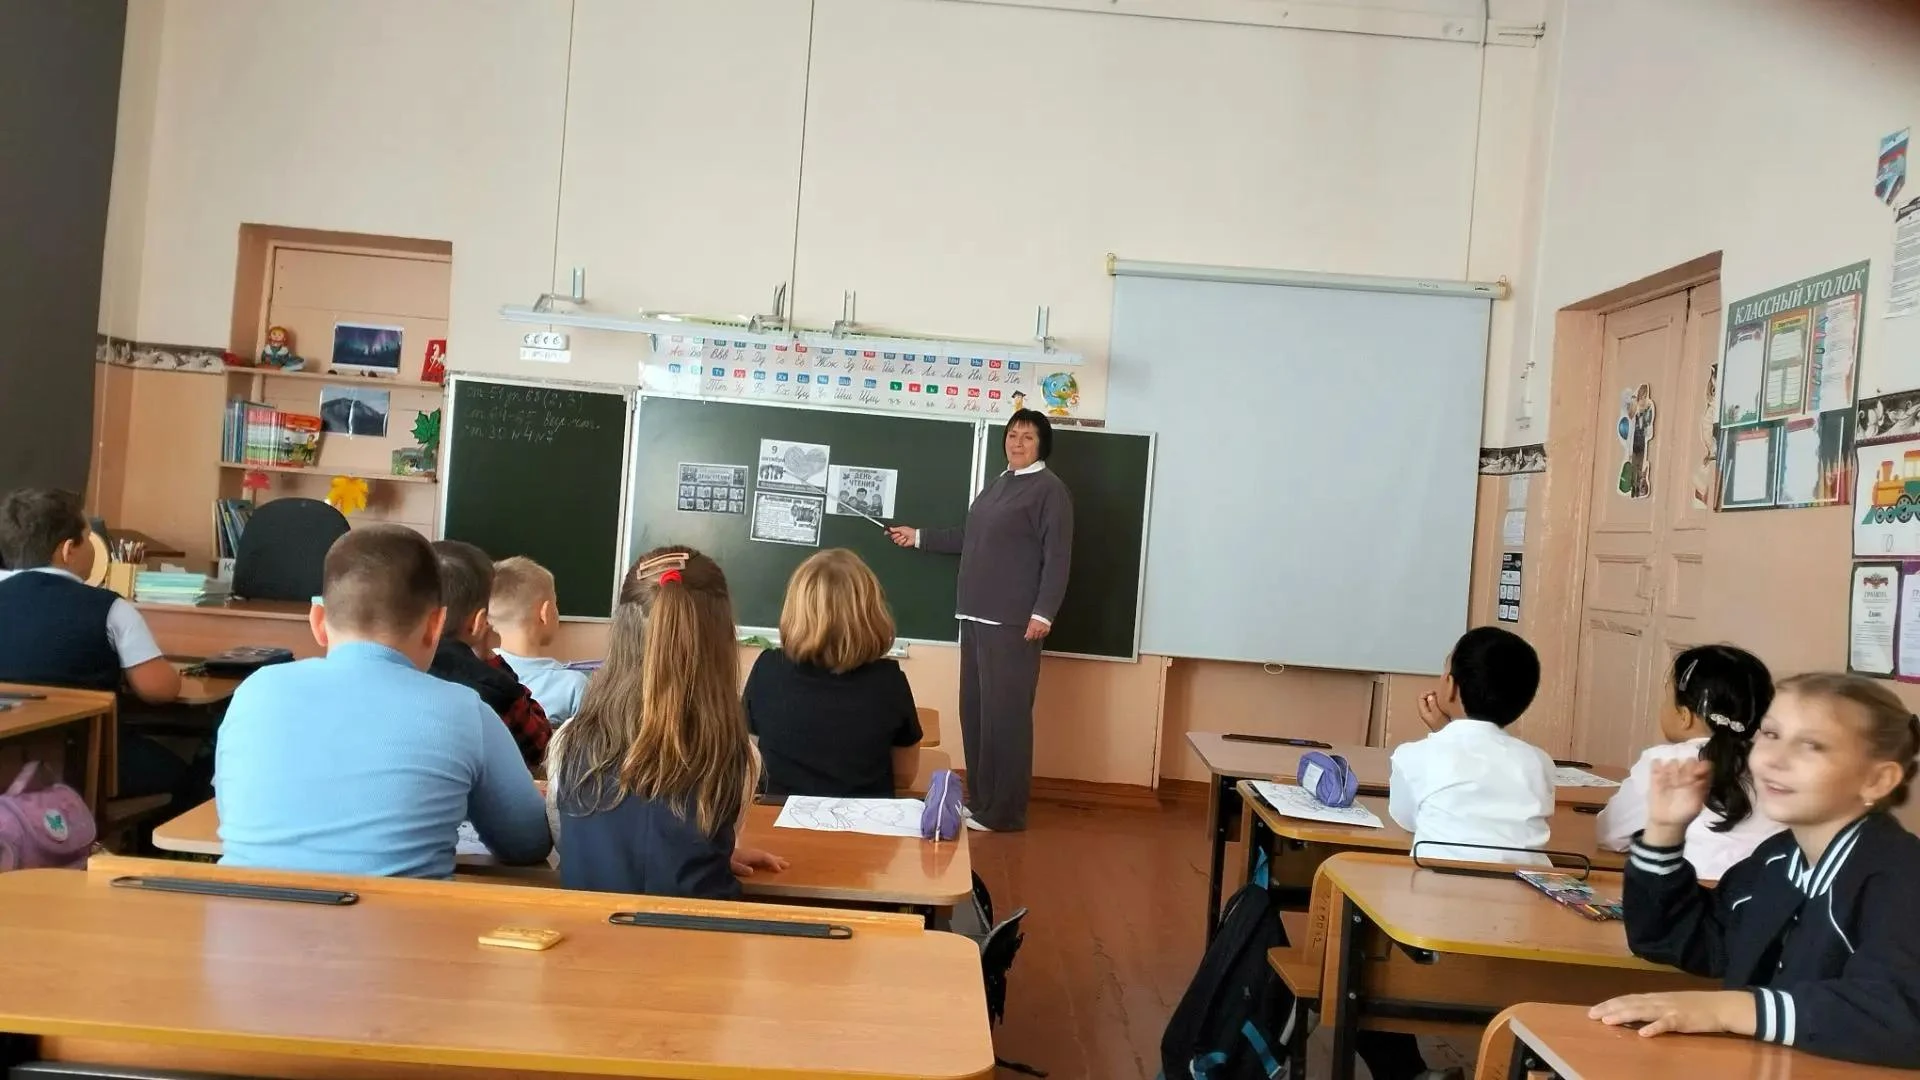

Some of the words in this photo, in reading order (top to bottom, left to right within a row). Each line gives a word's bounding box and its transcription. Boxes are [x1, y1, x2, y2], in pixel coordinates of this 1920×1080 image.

[1734, 284, 1804, 325] КЛАССНЫЙ
[1804, 268, 1866, 305] УГОЛОК
[771, 445, 778, 455] 9
[849, 479, 876, 488] ЧТЕНИЯ
